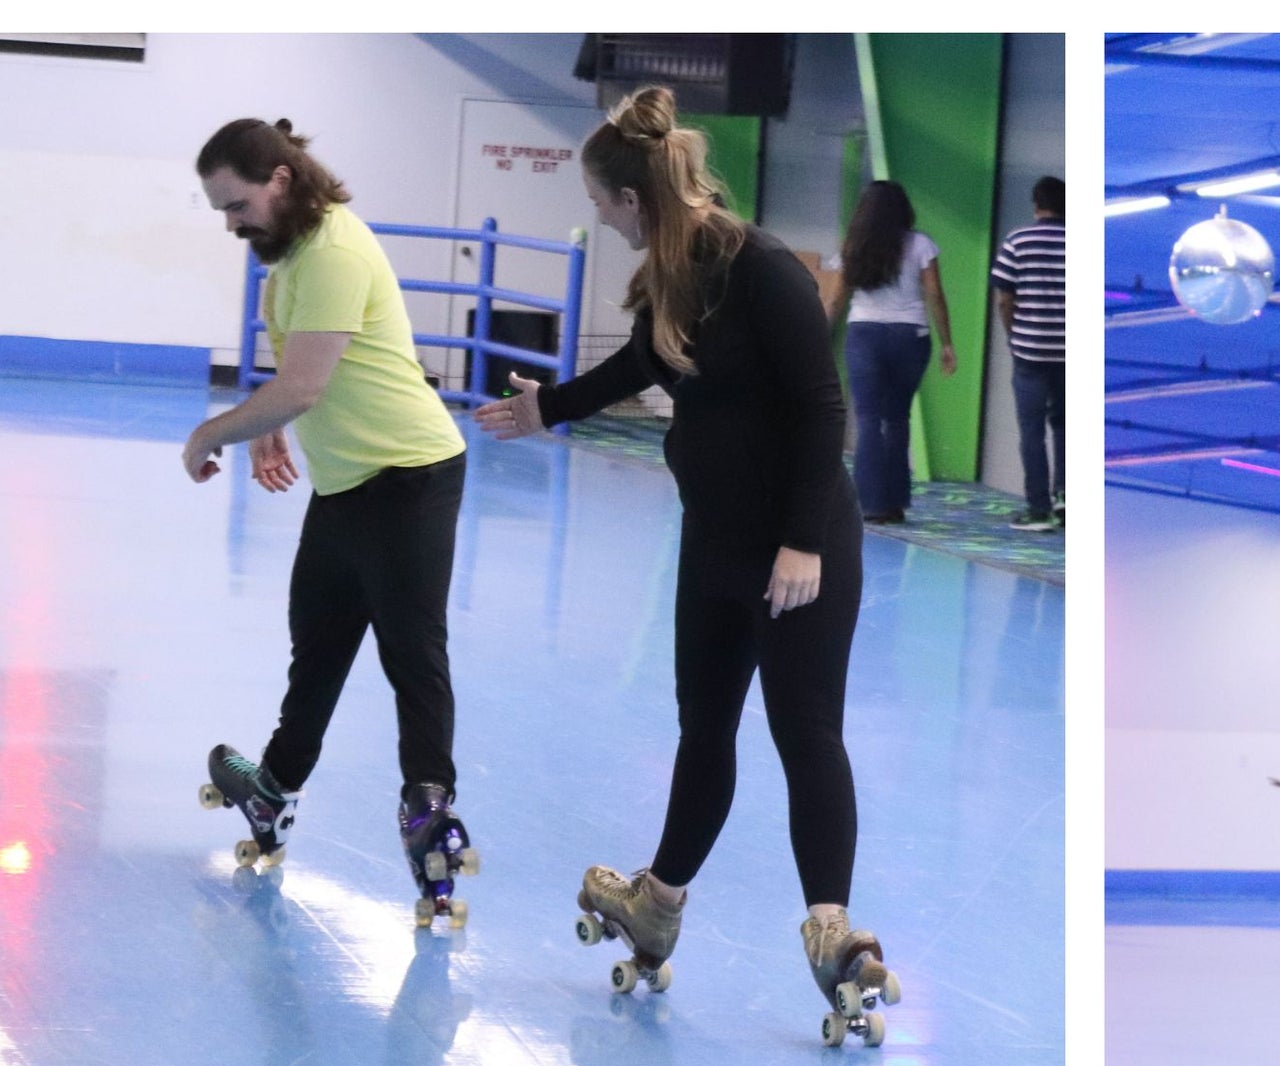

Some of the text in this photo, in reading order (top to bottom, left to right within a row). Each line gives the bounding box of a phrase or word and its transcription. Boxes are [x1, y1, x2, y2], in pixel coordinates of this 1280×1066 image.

[481, 145, 573, 160] FIRE SPRINKLER
[496, 160, 558, 173] NO EXIT
